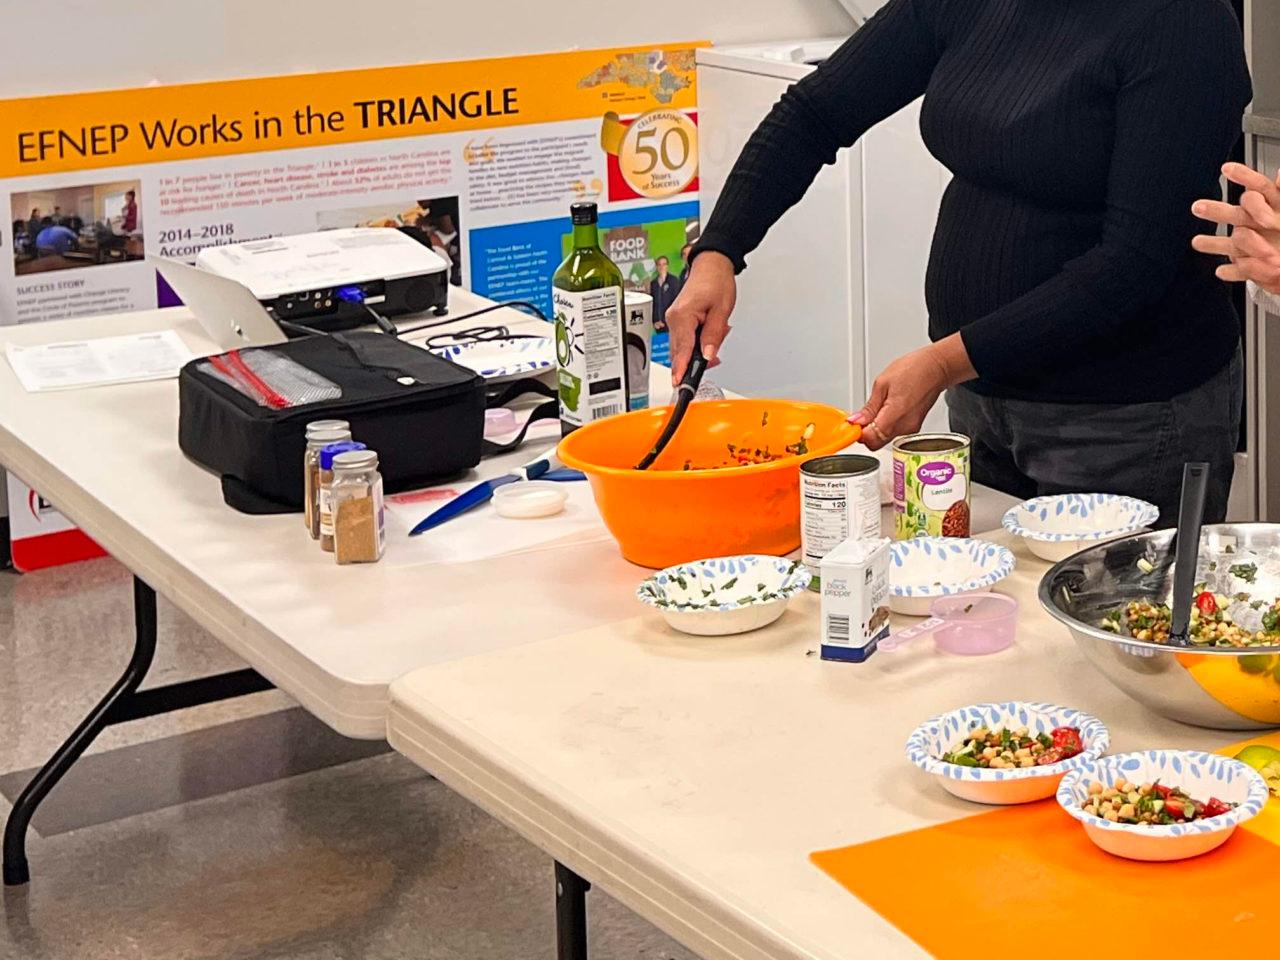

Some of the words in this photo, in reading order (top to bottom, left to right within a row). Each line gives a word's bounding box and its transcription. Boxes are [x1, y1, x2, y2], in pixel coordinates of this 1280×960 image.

[18, 124, 129, 163] EFNEP
[139, 114, 243, 150] Works
[254, 111, 282, 139] in
[294, 105, 345, 136] the
[353, 88, 520, 129] TRIANGLE
[637, 113, 682, 129] CELEBRATING
[632, 127, 690, 175] 50
[651, 172, 672, 181] Years
[651, 180, 680, 190] Success
[610, 237, 645, 252] FOOD
[610, 248, 646, 262] BANK
[920, 467, 952, 479] Organic
[825, 590, 852, 598] pepper
